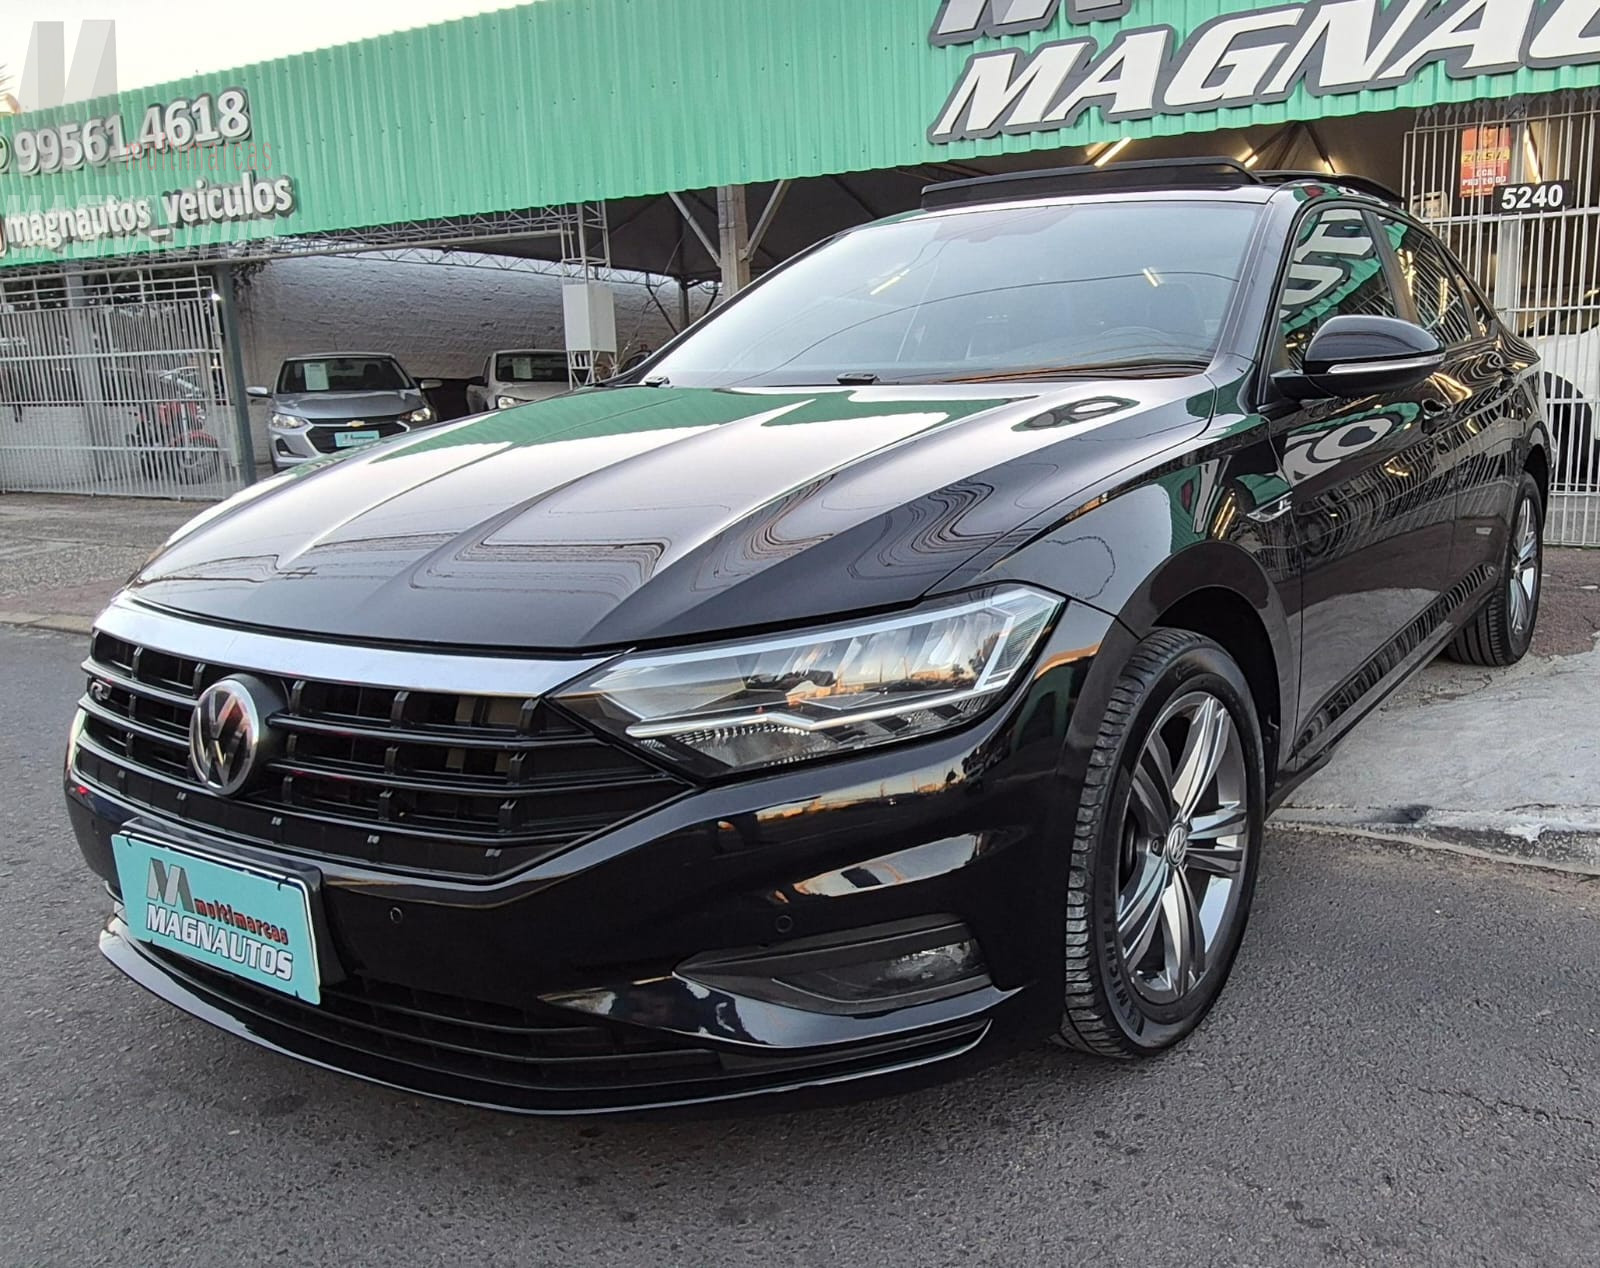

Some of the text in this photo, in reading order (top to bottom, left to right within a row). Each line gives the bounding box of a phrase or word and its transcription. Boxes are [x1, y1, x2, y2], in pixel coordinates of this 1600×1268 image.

[1501, 184, 1563, 210] 5240
[146, 903, 294, 982] MAGNAUTOS
[194, 898, 289, 946] multimarcas
